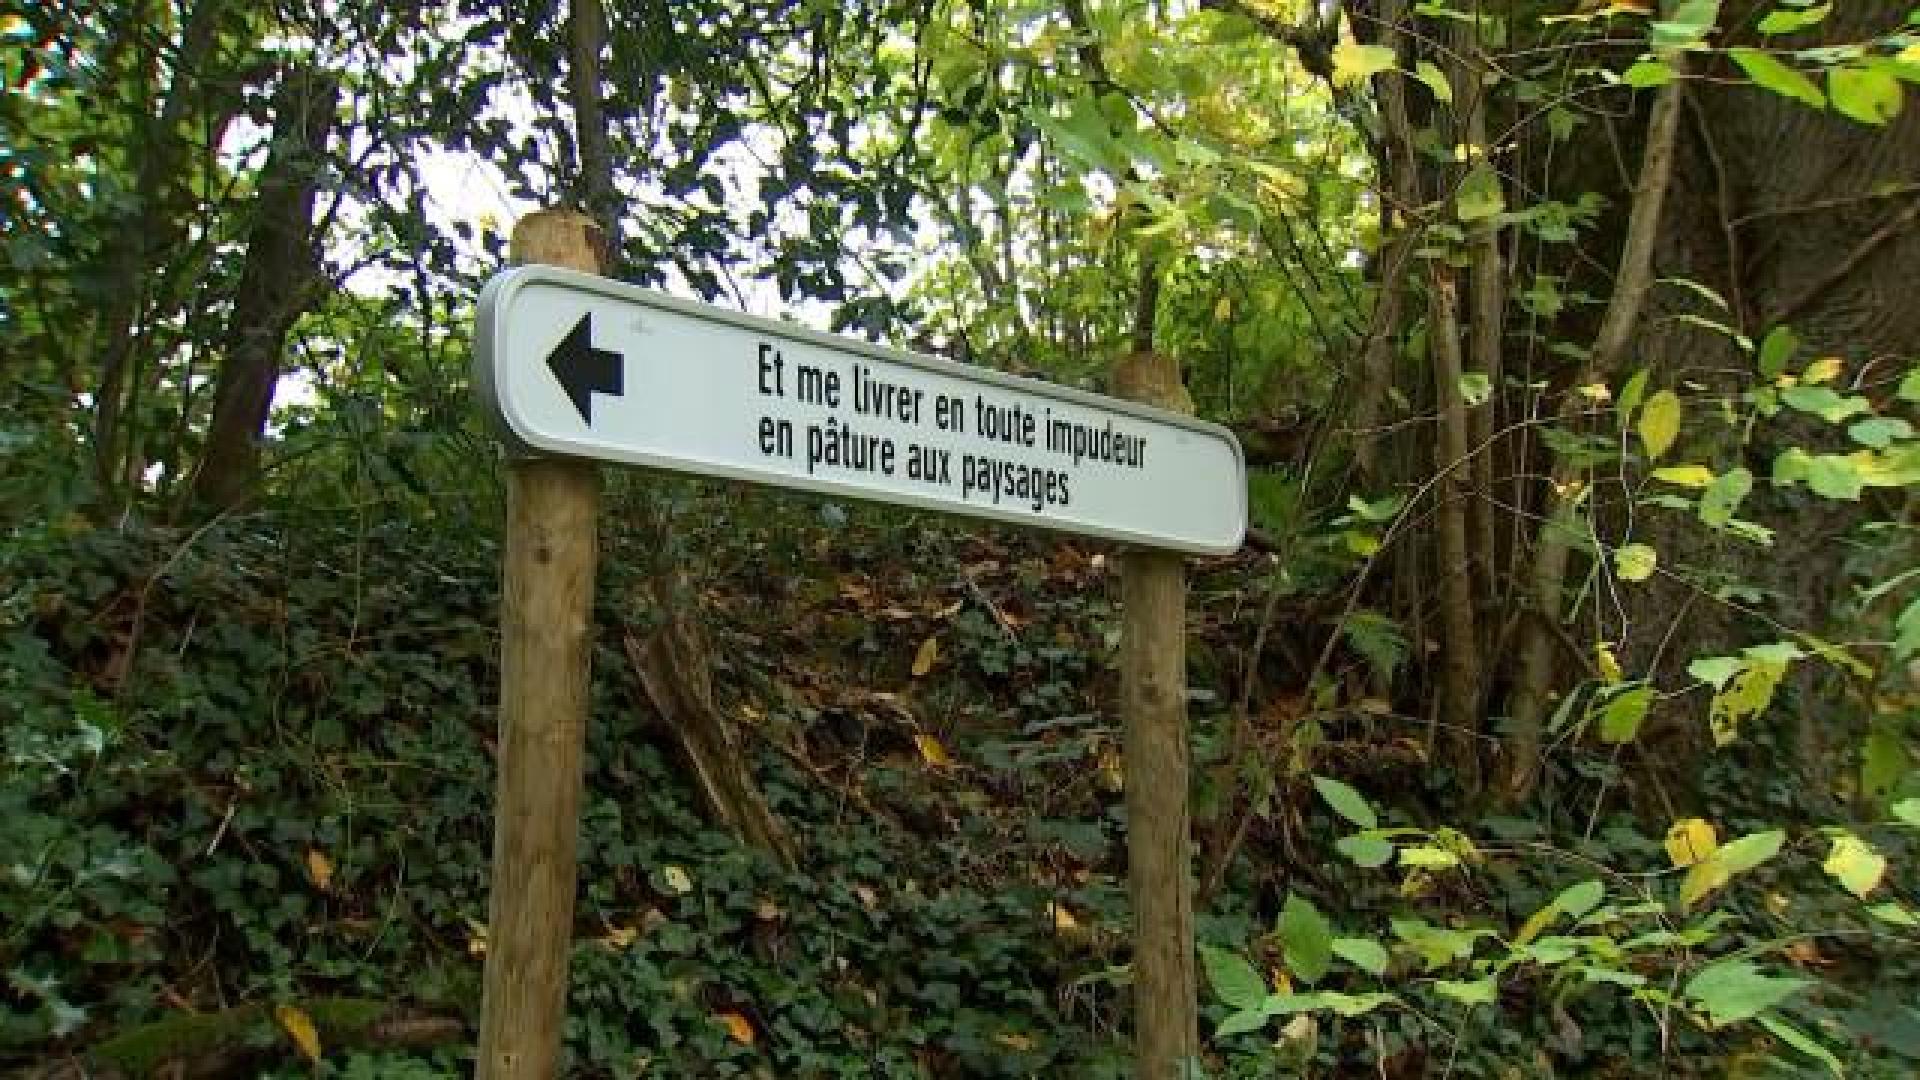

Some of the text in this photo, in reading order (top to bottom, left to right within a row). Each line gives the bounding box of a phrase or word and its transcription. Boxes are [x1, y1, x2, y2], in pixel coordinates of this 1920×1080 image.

[758, 342, 1147, 468] Et me livrer en toute impudeur
[758, 415, 1069, 512] en pâture aux paysages
